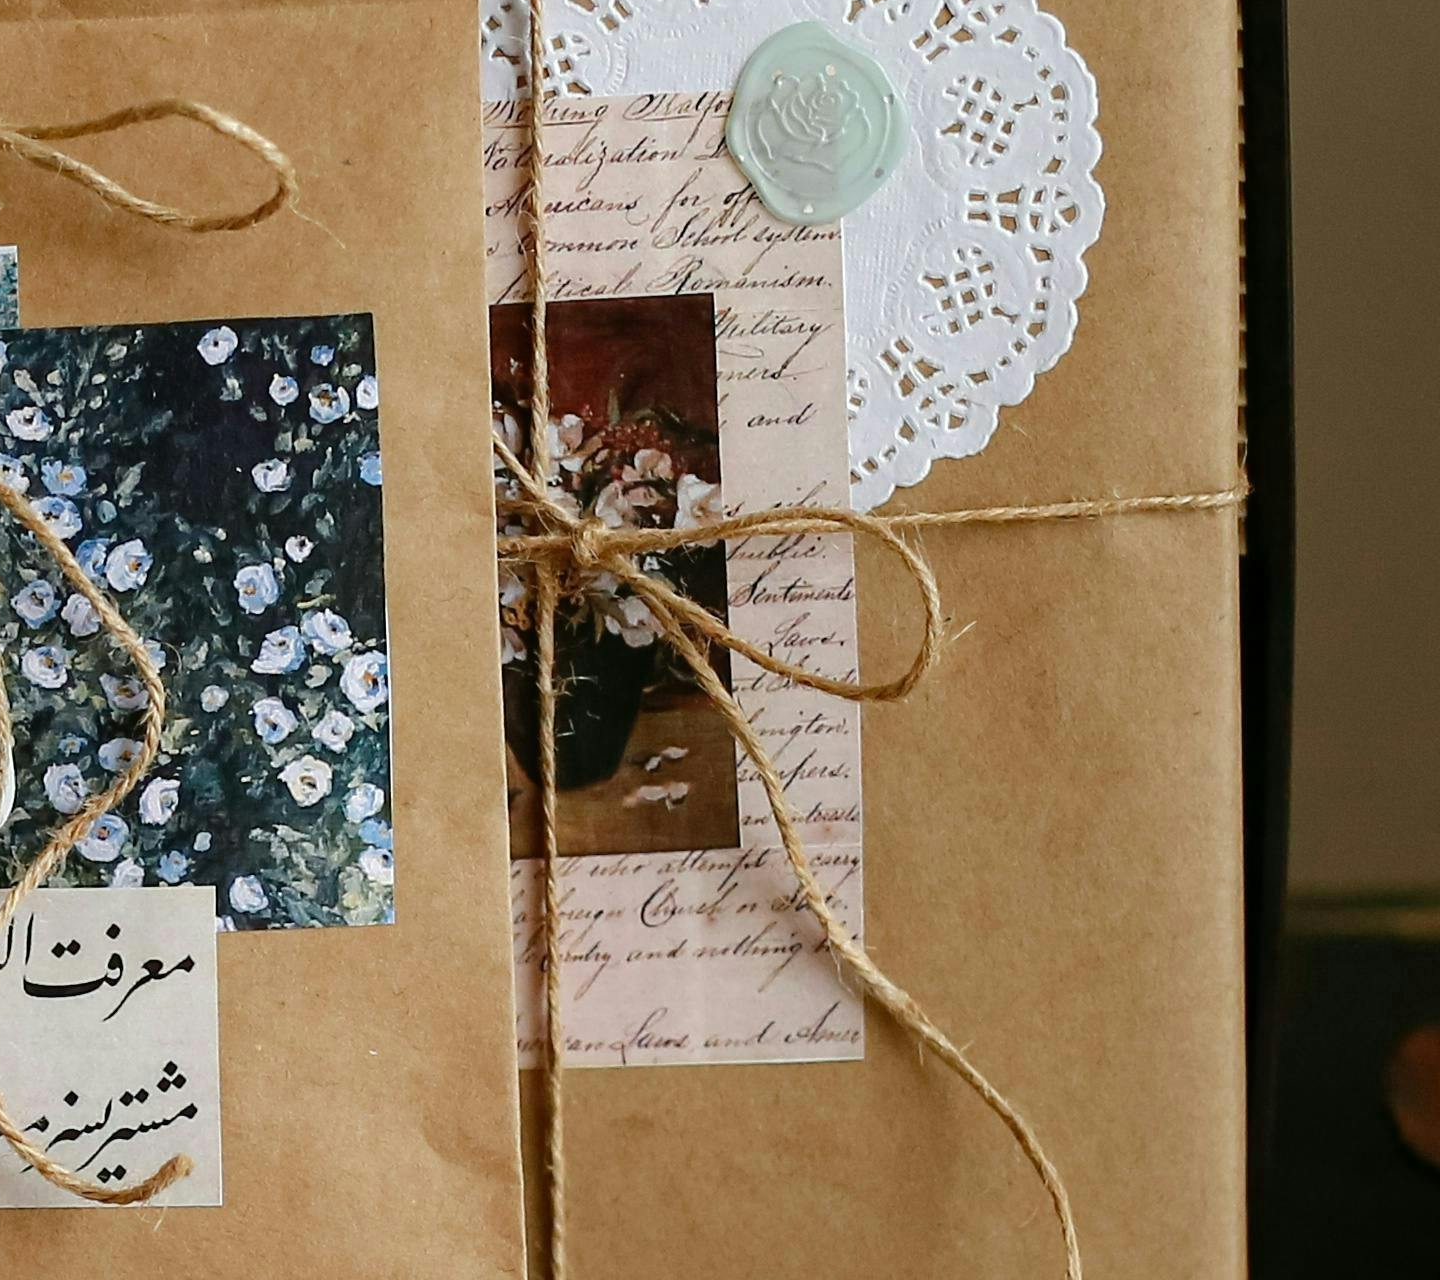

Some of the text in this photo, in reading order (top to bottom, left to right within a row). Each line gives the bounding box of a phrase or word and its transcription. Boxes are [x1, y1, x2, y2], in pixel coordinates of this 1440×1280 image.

[484, 135, 686, 191] Natralization
[651, 167, 717, 234] for
[652, 207, 760, 250] School
[646, 254, 833, 295] Romanism.
[747, 402, 816, 428] and
[729, 560, 855, 608] Sentiments
